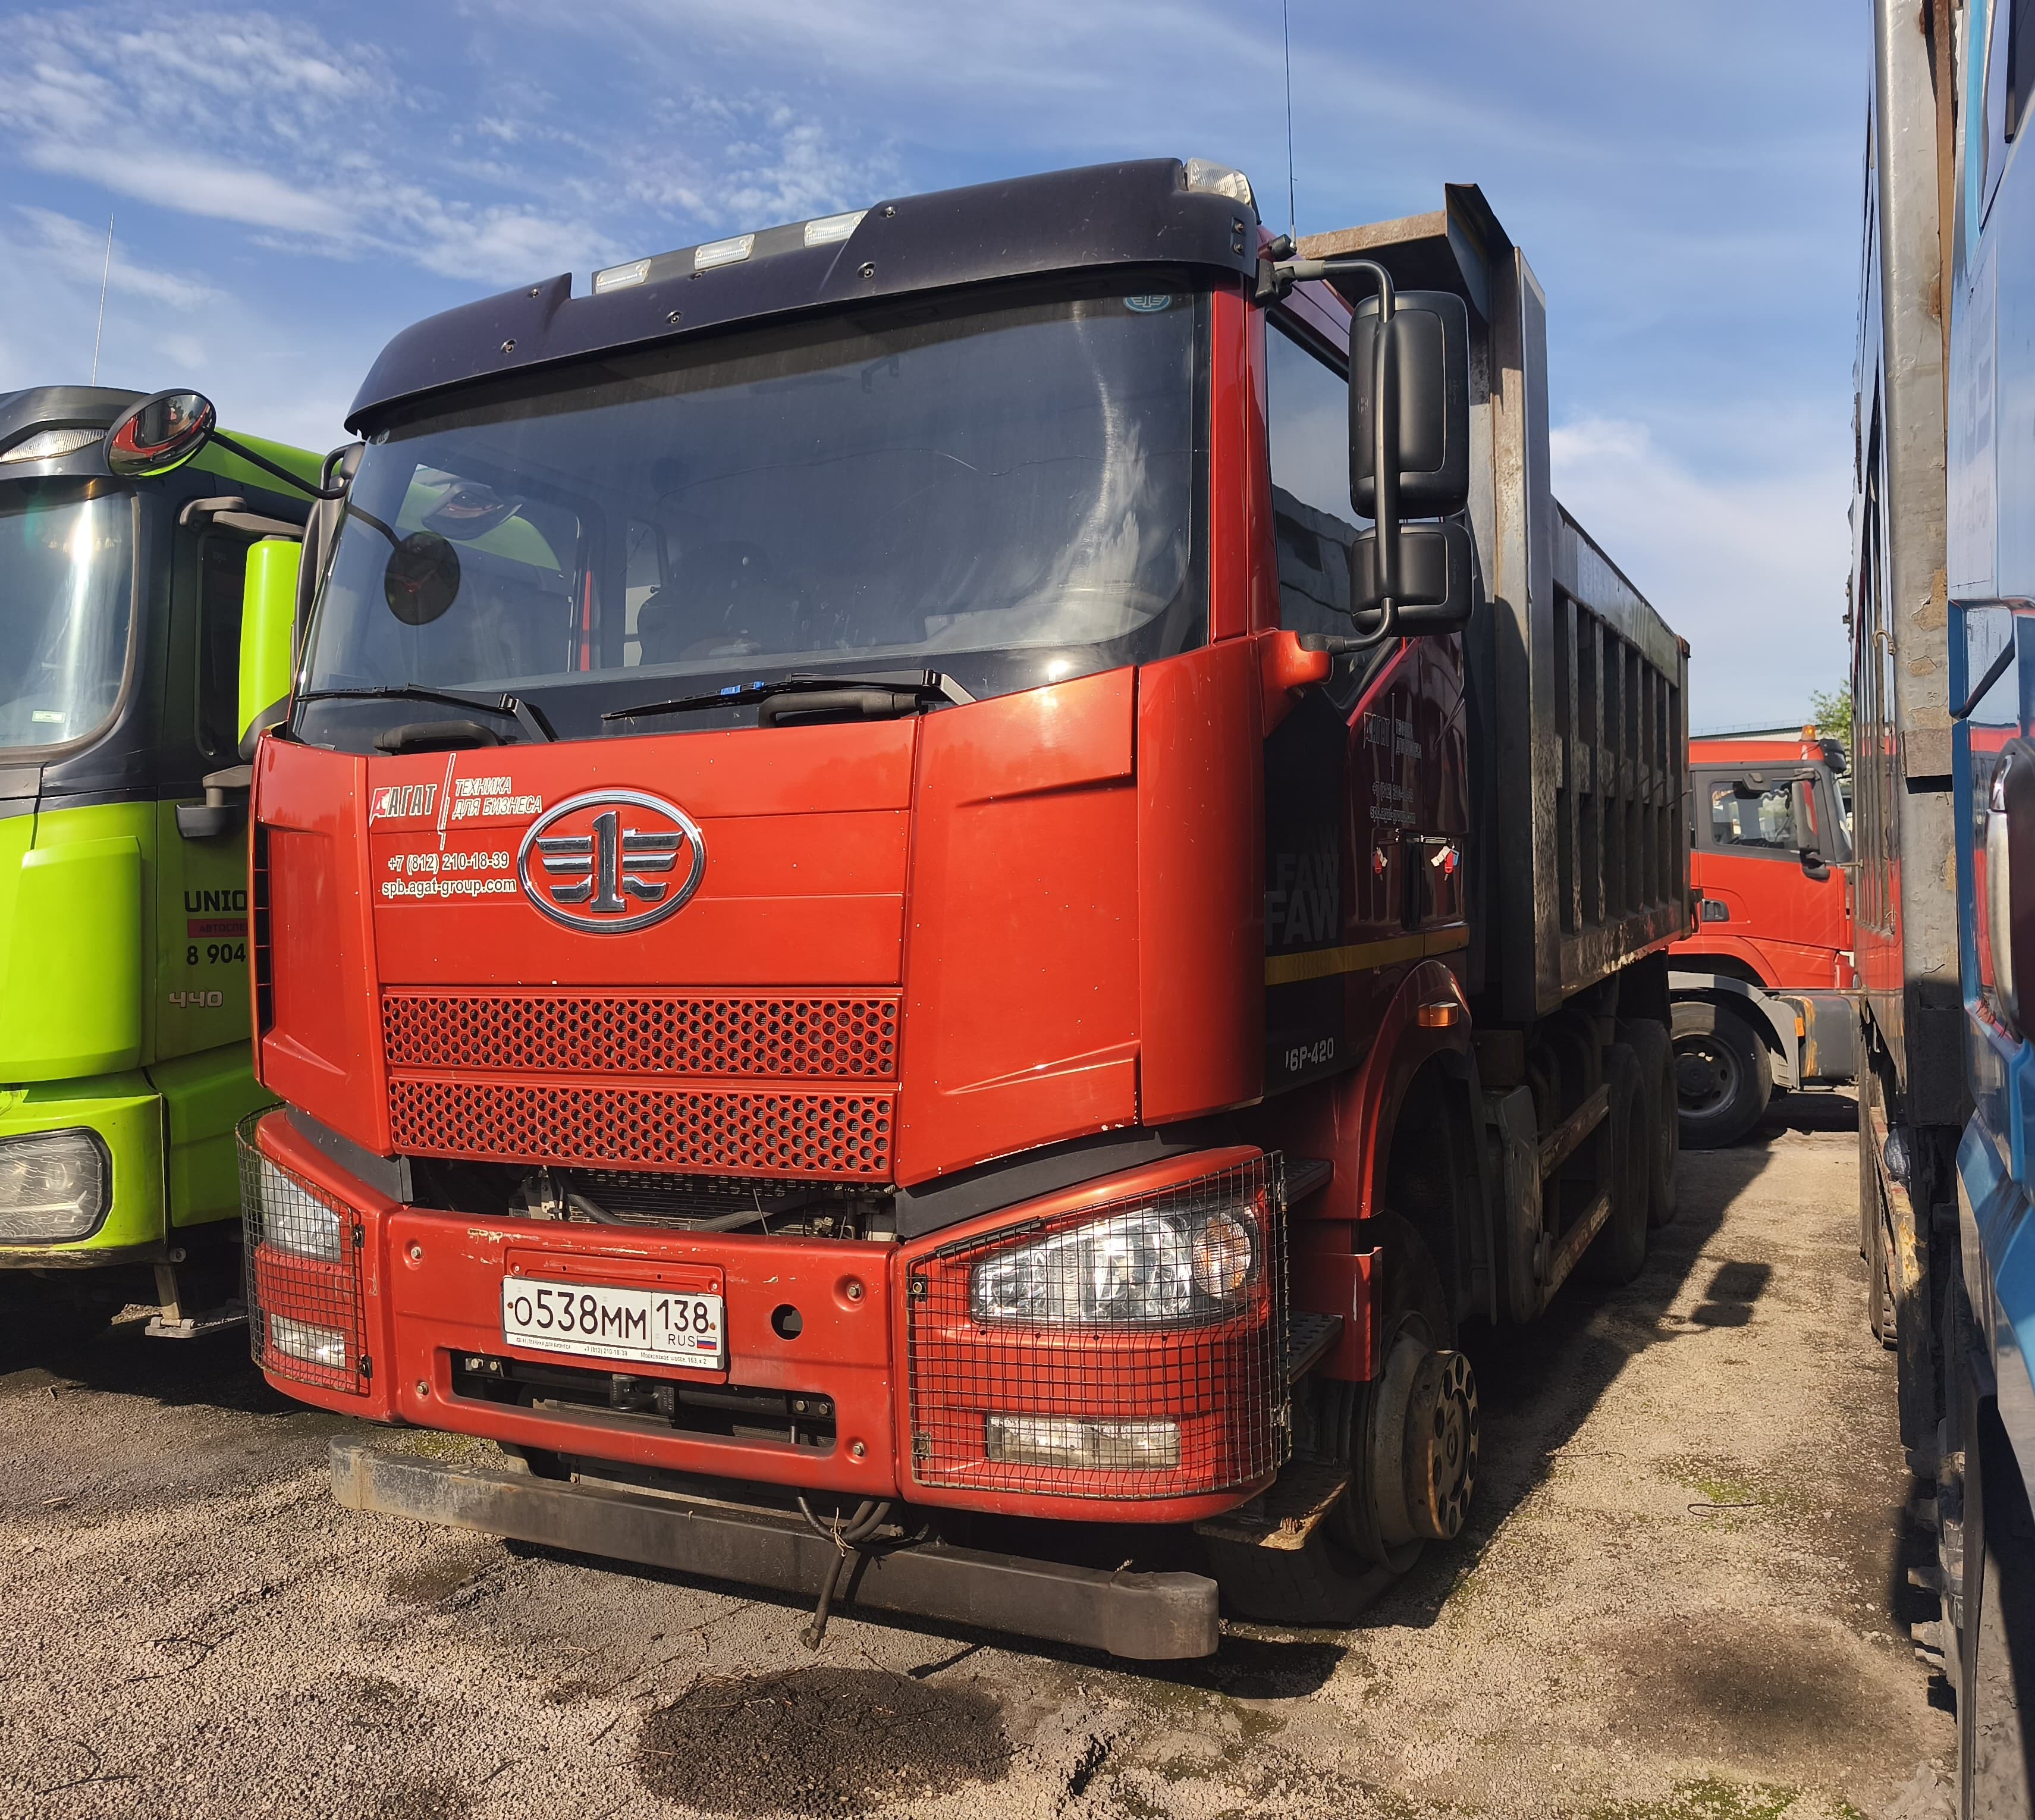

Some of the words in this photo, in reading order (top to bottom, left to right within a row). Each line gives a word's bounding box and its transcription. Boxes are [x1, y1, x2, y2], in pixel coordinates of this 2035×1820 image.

[454, 776, 512, 796] ТЕХНИКА
[388, 783, 437, 818] АГАТ
[452, 798, 480, 820] ДЛЯ
[483, 795, 542, 816] БИЗНЕСА
[388, 855, 403, 873] +7
[406, 853, 439, 876] (812)
[442, 851, 509, 870] 210-18-39
[382, 877, 517, 899] spb.agat-group.com
[199, 922, 247, 933] АВТОСПЕ
[1265, 888, 1340, 946] FAW
[187, 945, 199, 965] 8
[207, 943, 246, 964] 904
[169, 990, 223, 1008] 440
[656, 1299, 709, 1334] 138
[667, 1333, 695, 1348] RUS
